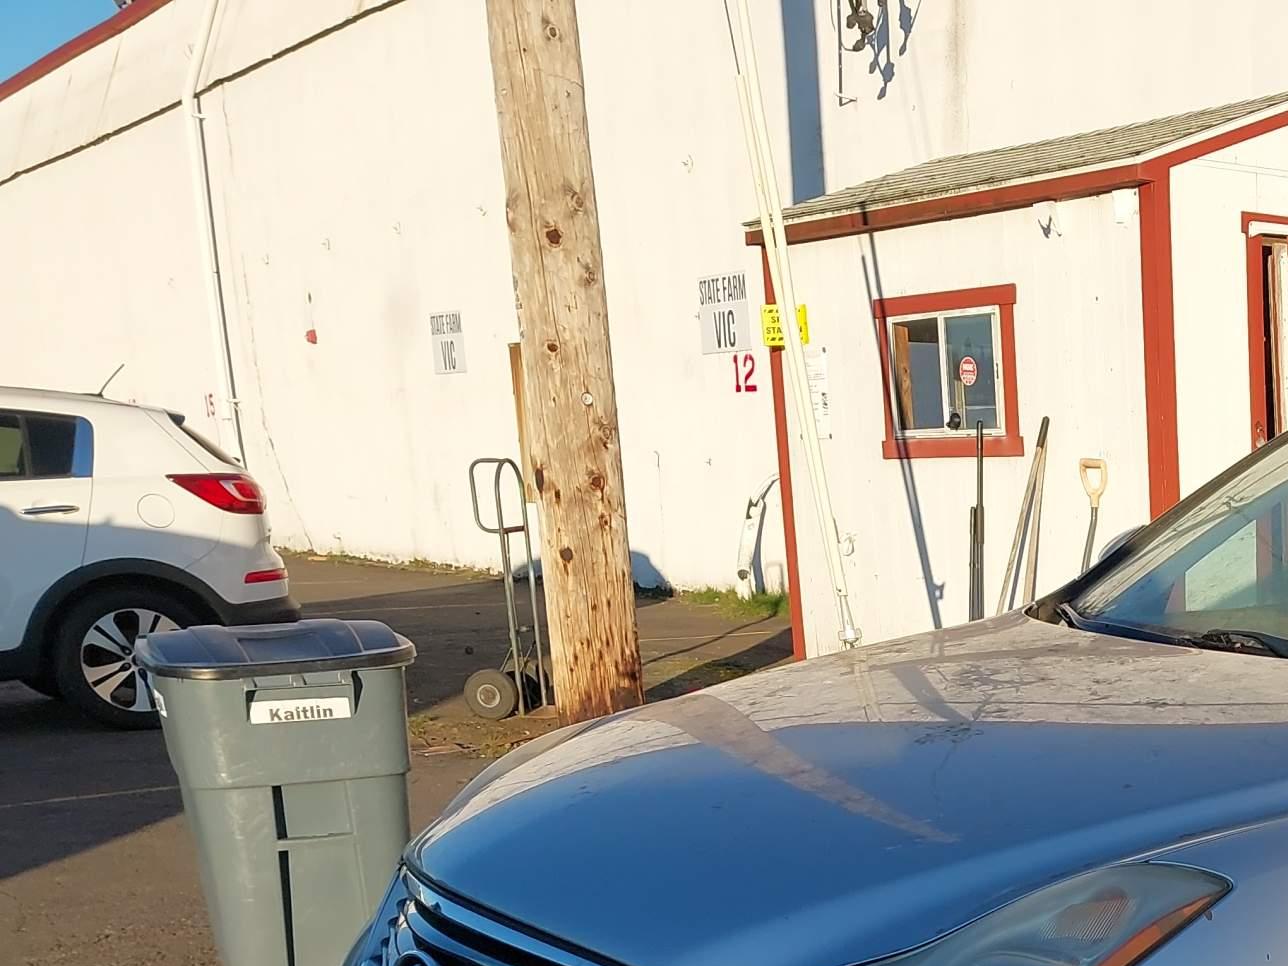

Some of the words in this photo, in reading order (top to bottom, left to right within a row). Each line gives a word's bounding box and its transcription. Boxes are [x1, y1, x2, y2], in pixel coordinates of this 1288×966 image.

[699, 278, 721, 305] STATE
[722, 274, 747, 303] FARM
[713, 310, 736, 349] VIC
[440, 340, 456, 370] VIC
[733, 354, 757, 392] 12
[269, 705, 334, 721] Kaitlin
